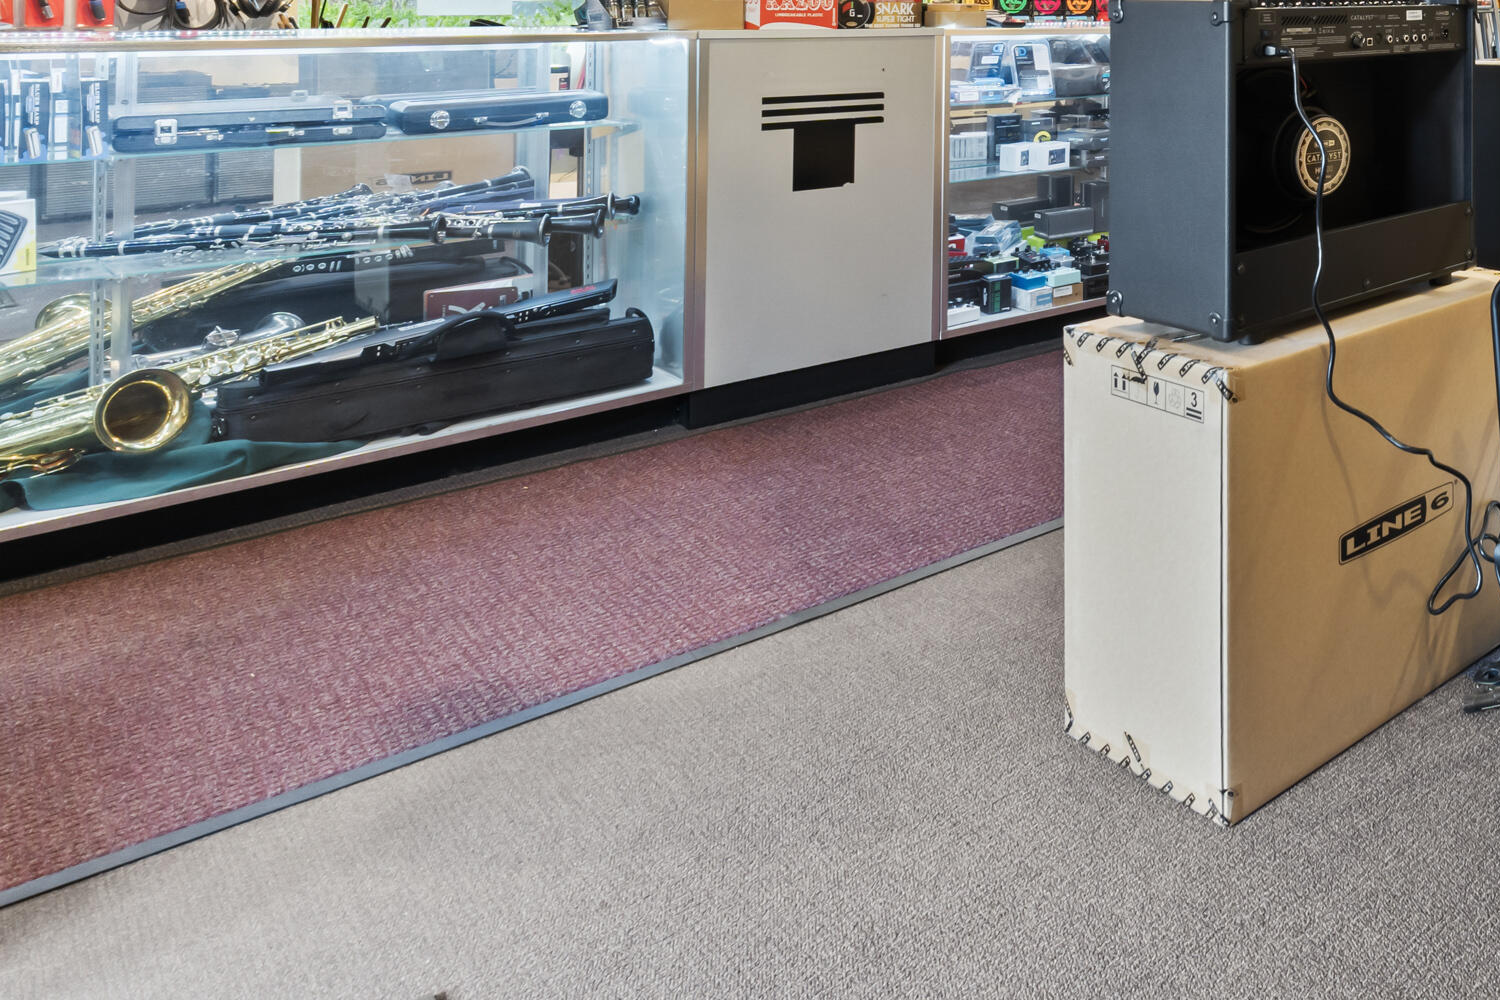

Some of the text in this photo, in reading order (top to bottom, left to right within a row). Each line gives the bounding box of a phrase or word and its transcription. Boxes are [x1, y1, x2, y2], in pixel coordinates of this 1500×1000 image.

[876, 1, 914, 15] SNARK
[897, 15, 915, 23] TIGHT
[1307, 151, 1342, 163] CATYST
[1191, 392, 1198, 408] 3
[1344, 489, 1449, 560] LINE 6
